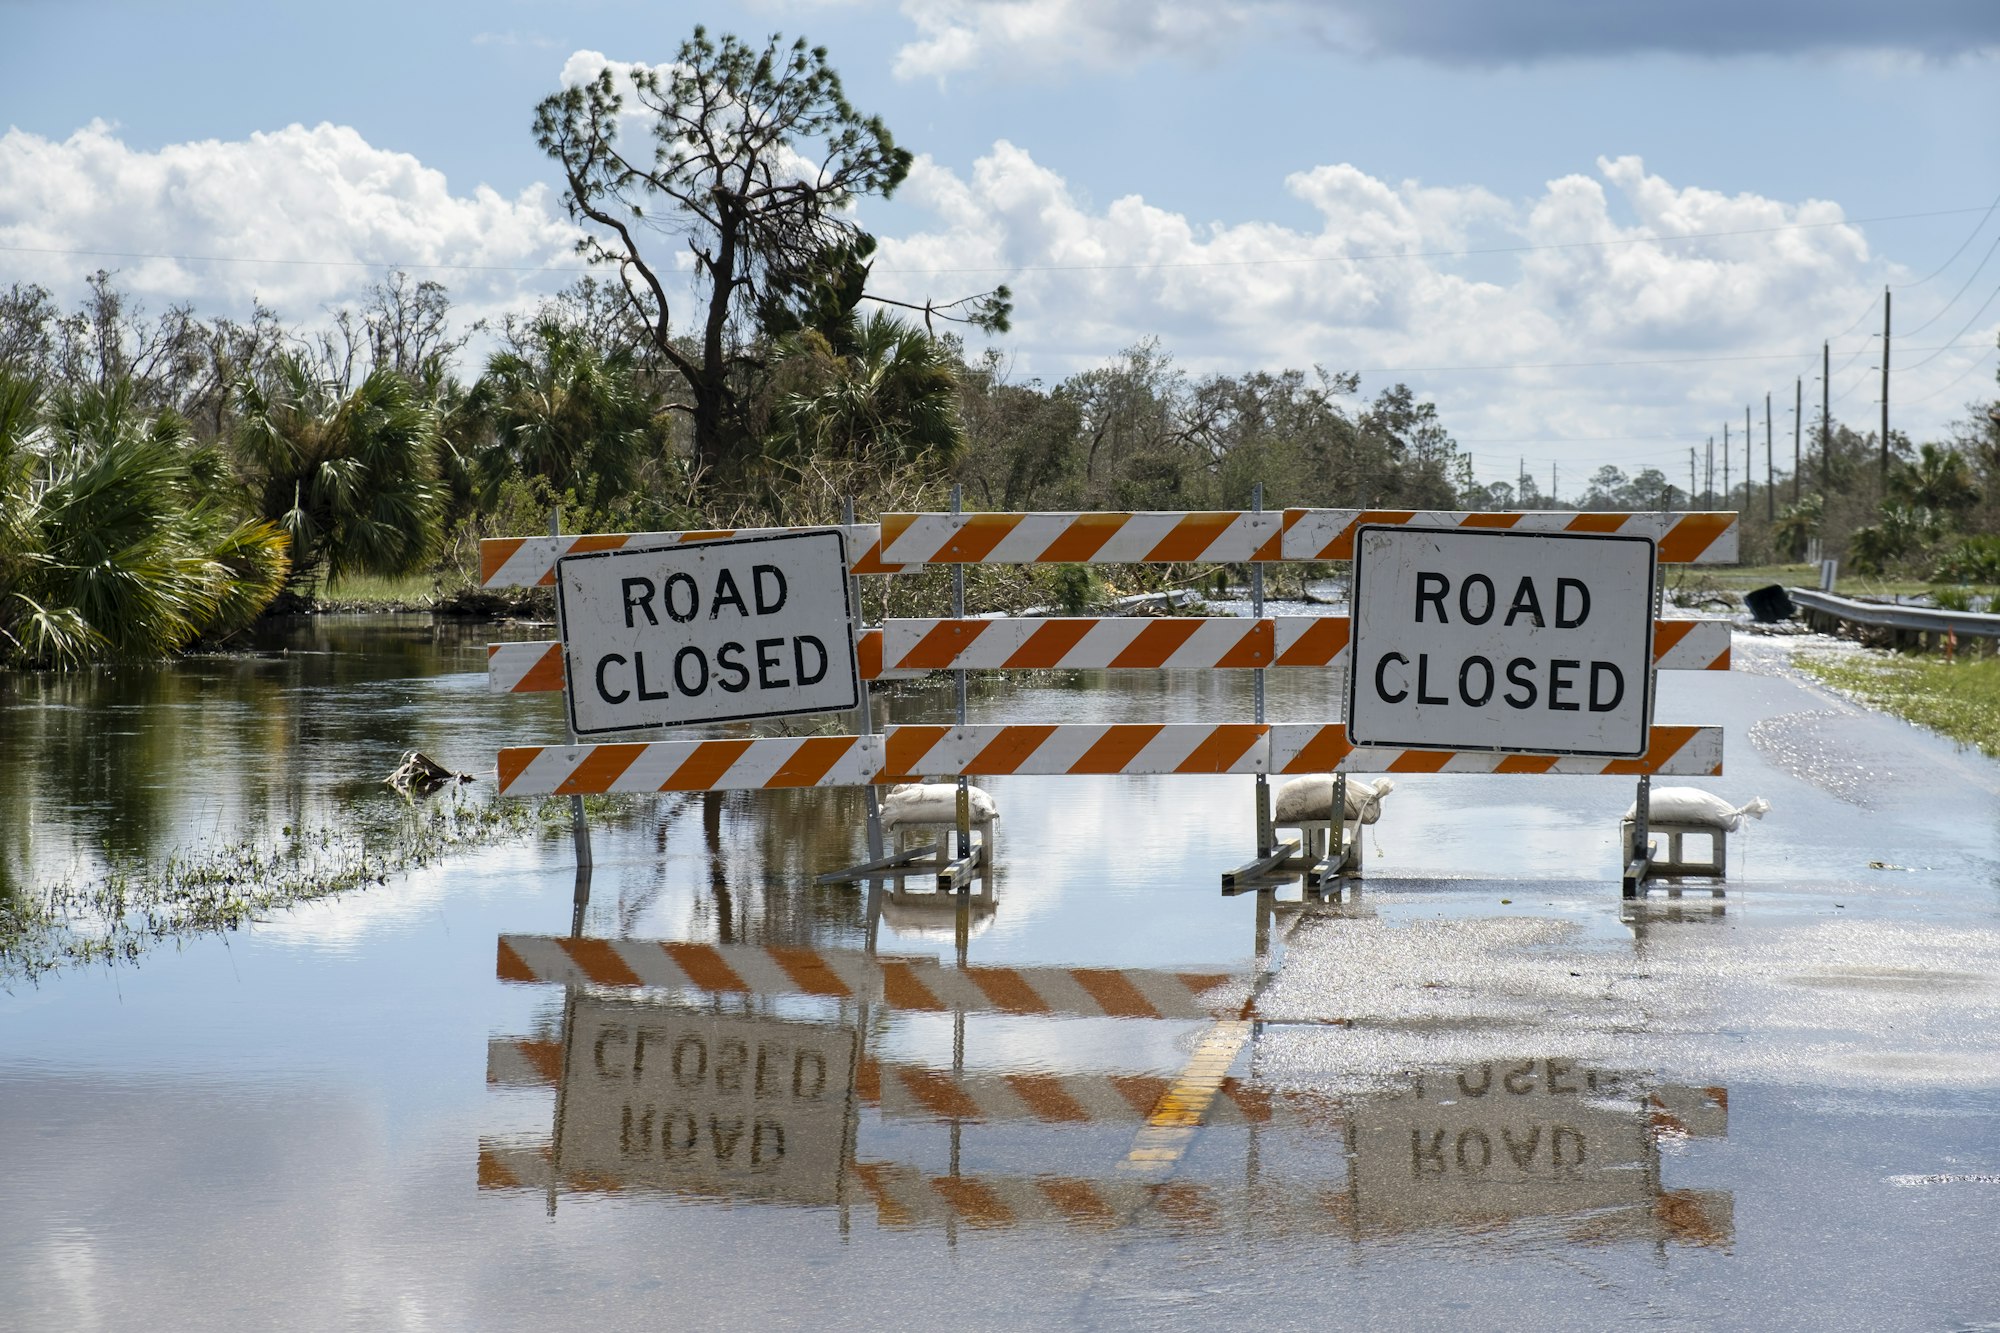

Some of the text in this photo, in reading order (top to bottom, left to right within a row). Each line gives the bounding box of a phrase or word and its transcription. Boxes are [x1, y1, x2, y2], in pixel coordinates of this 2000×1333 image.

[622, 564, 788, 628] ROAD
[1415, 571, 1591, 629] ROAD
[596, 635, 828, 704] CLOSED
[1375, 651, 1625, 712] CLOSED
